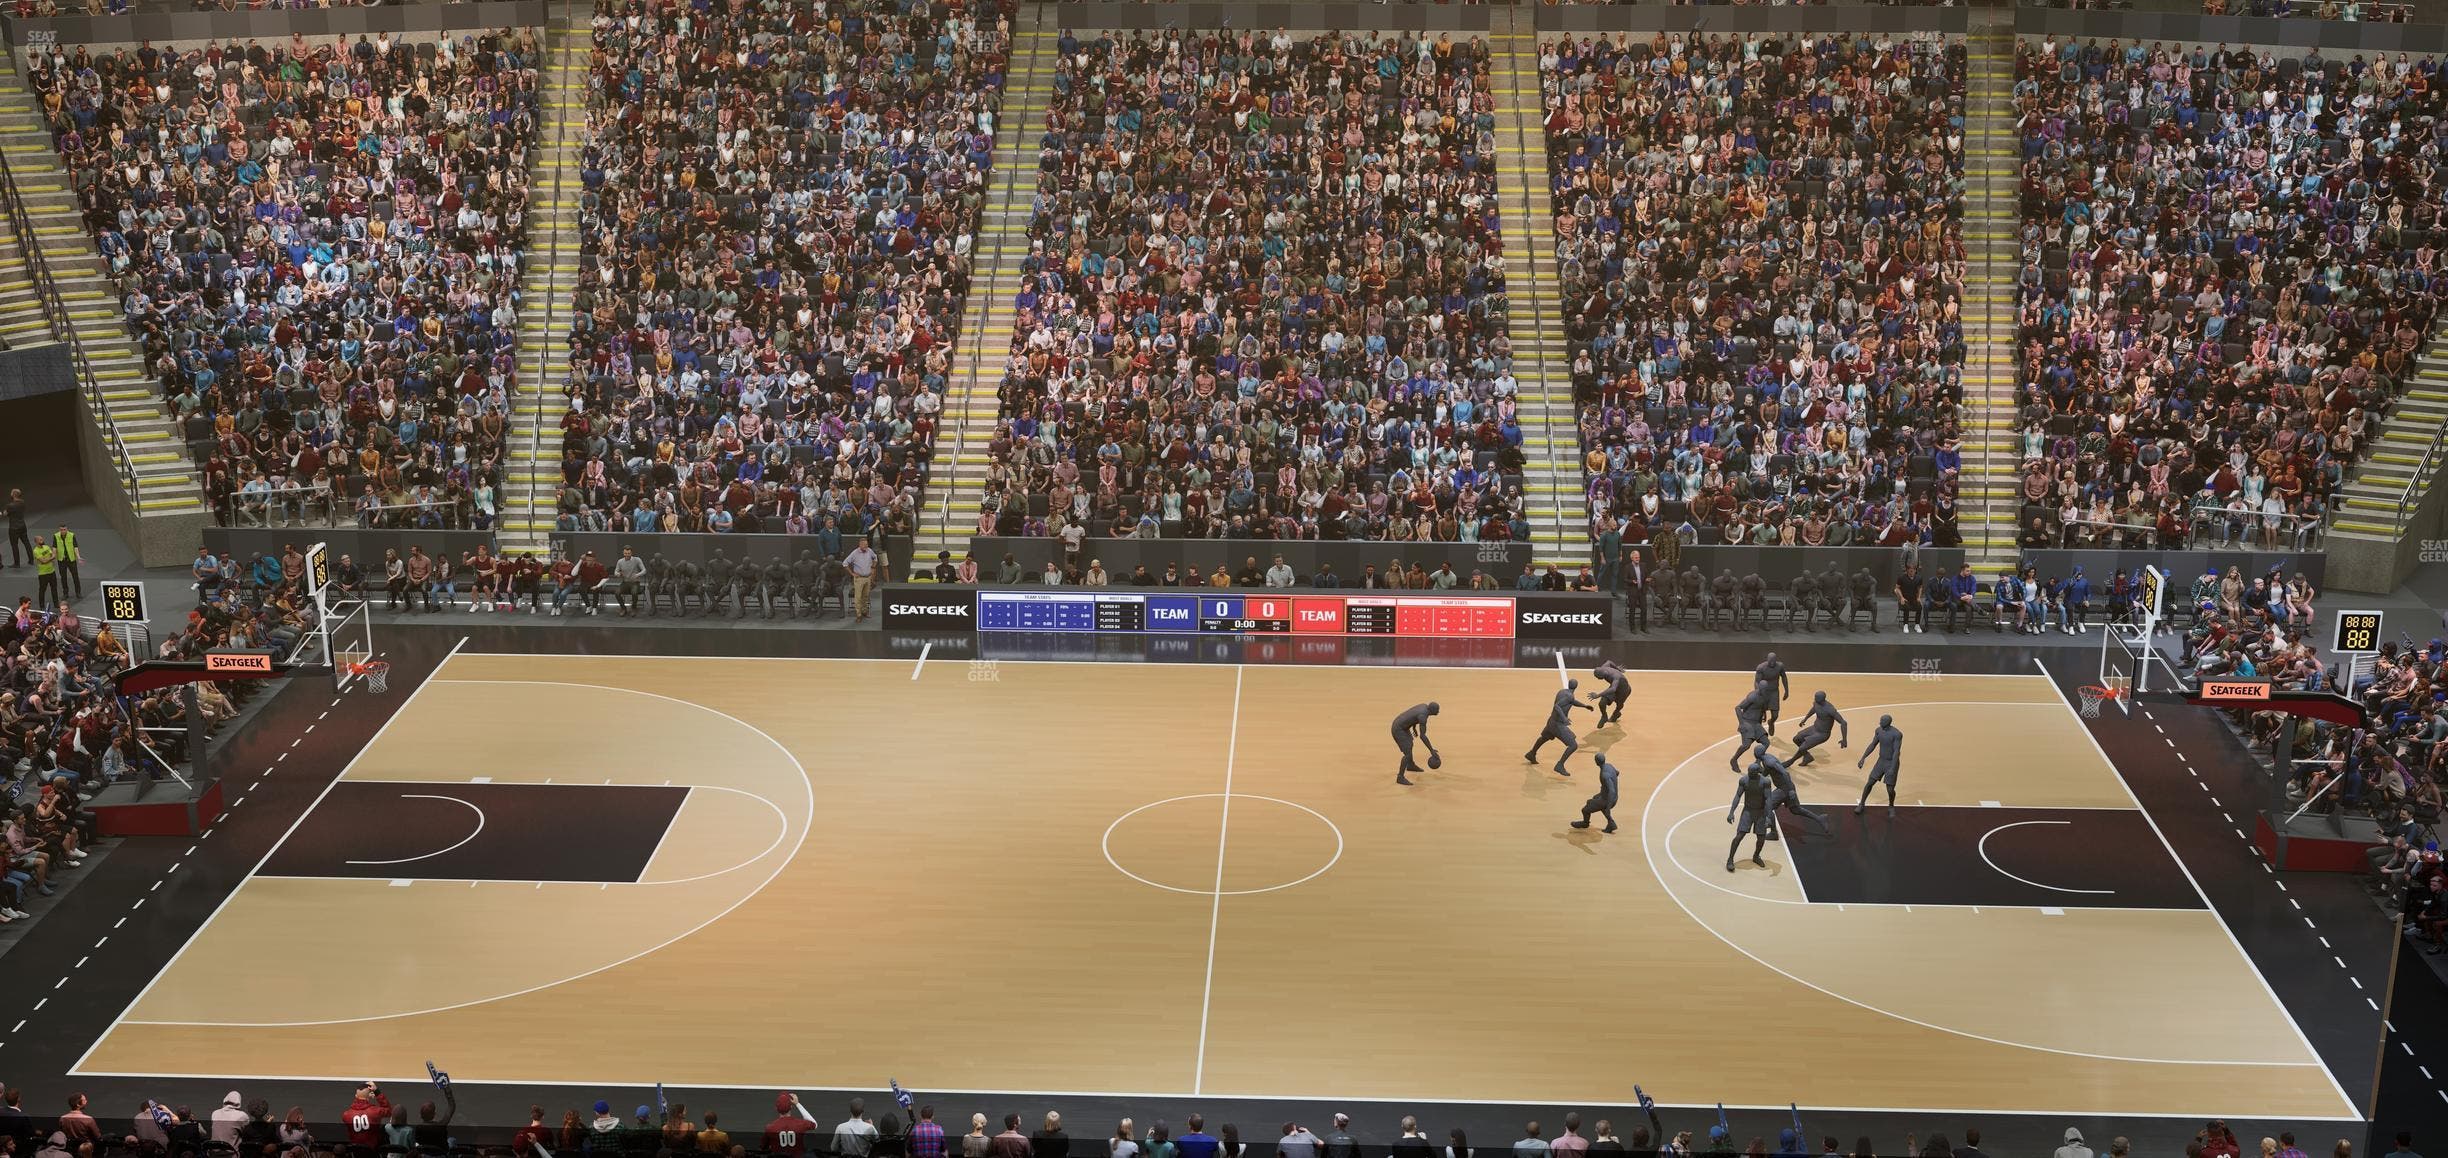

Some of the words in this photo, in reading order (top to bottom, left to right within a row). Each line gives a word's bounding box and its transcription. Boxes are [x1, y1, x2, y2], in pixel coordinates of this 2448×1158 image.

[108, 587, 121, 598] 88
[123, 587, 136, 598] 88
[113, 600, 136, 618] 88
[890, 604, 969, 617] SEATGEEK
[1153, 608, 1189, 620] TEAM
[1216, 602, 1228, 617] 0
[1263, 602, 1275, 617] 0
[1300, 610, 1336, 622] TEAM
[1522, 612, 1603, 625] SEATGEEK
[2346, 617, 2360, 628] 88
[2362, 617, 2376, 628] 88
[1235, 620, 1256, 628] 0:00
[2347, 630, 2370, 649] 88
[212, 657, 265, 668] SEATGEEK
[2210, 685, 2263, 696] SEATGEEK
[353, 1114, 370, 1133] 00
[779, 1130, 796, 1148] 00
